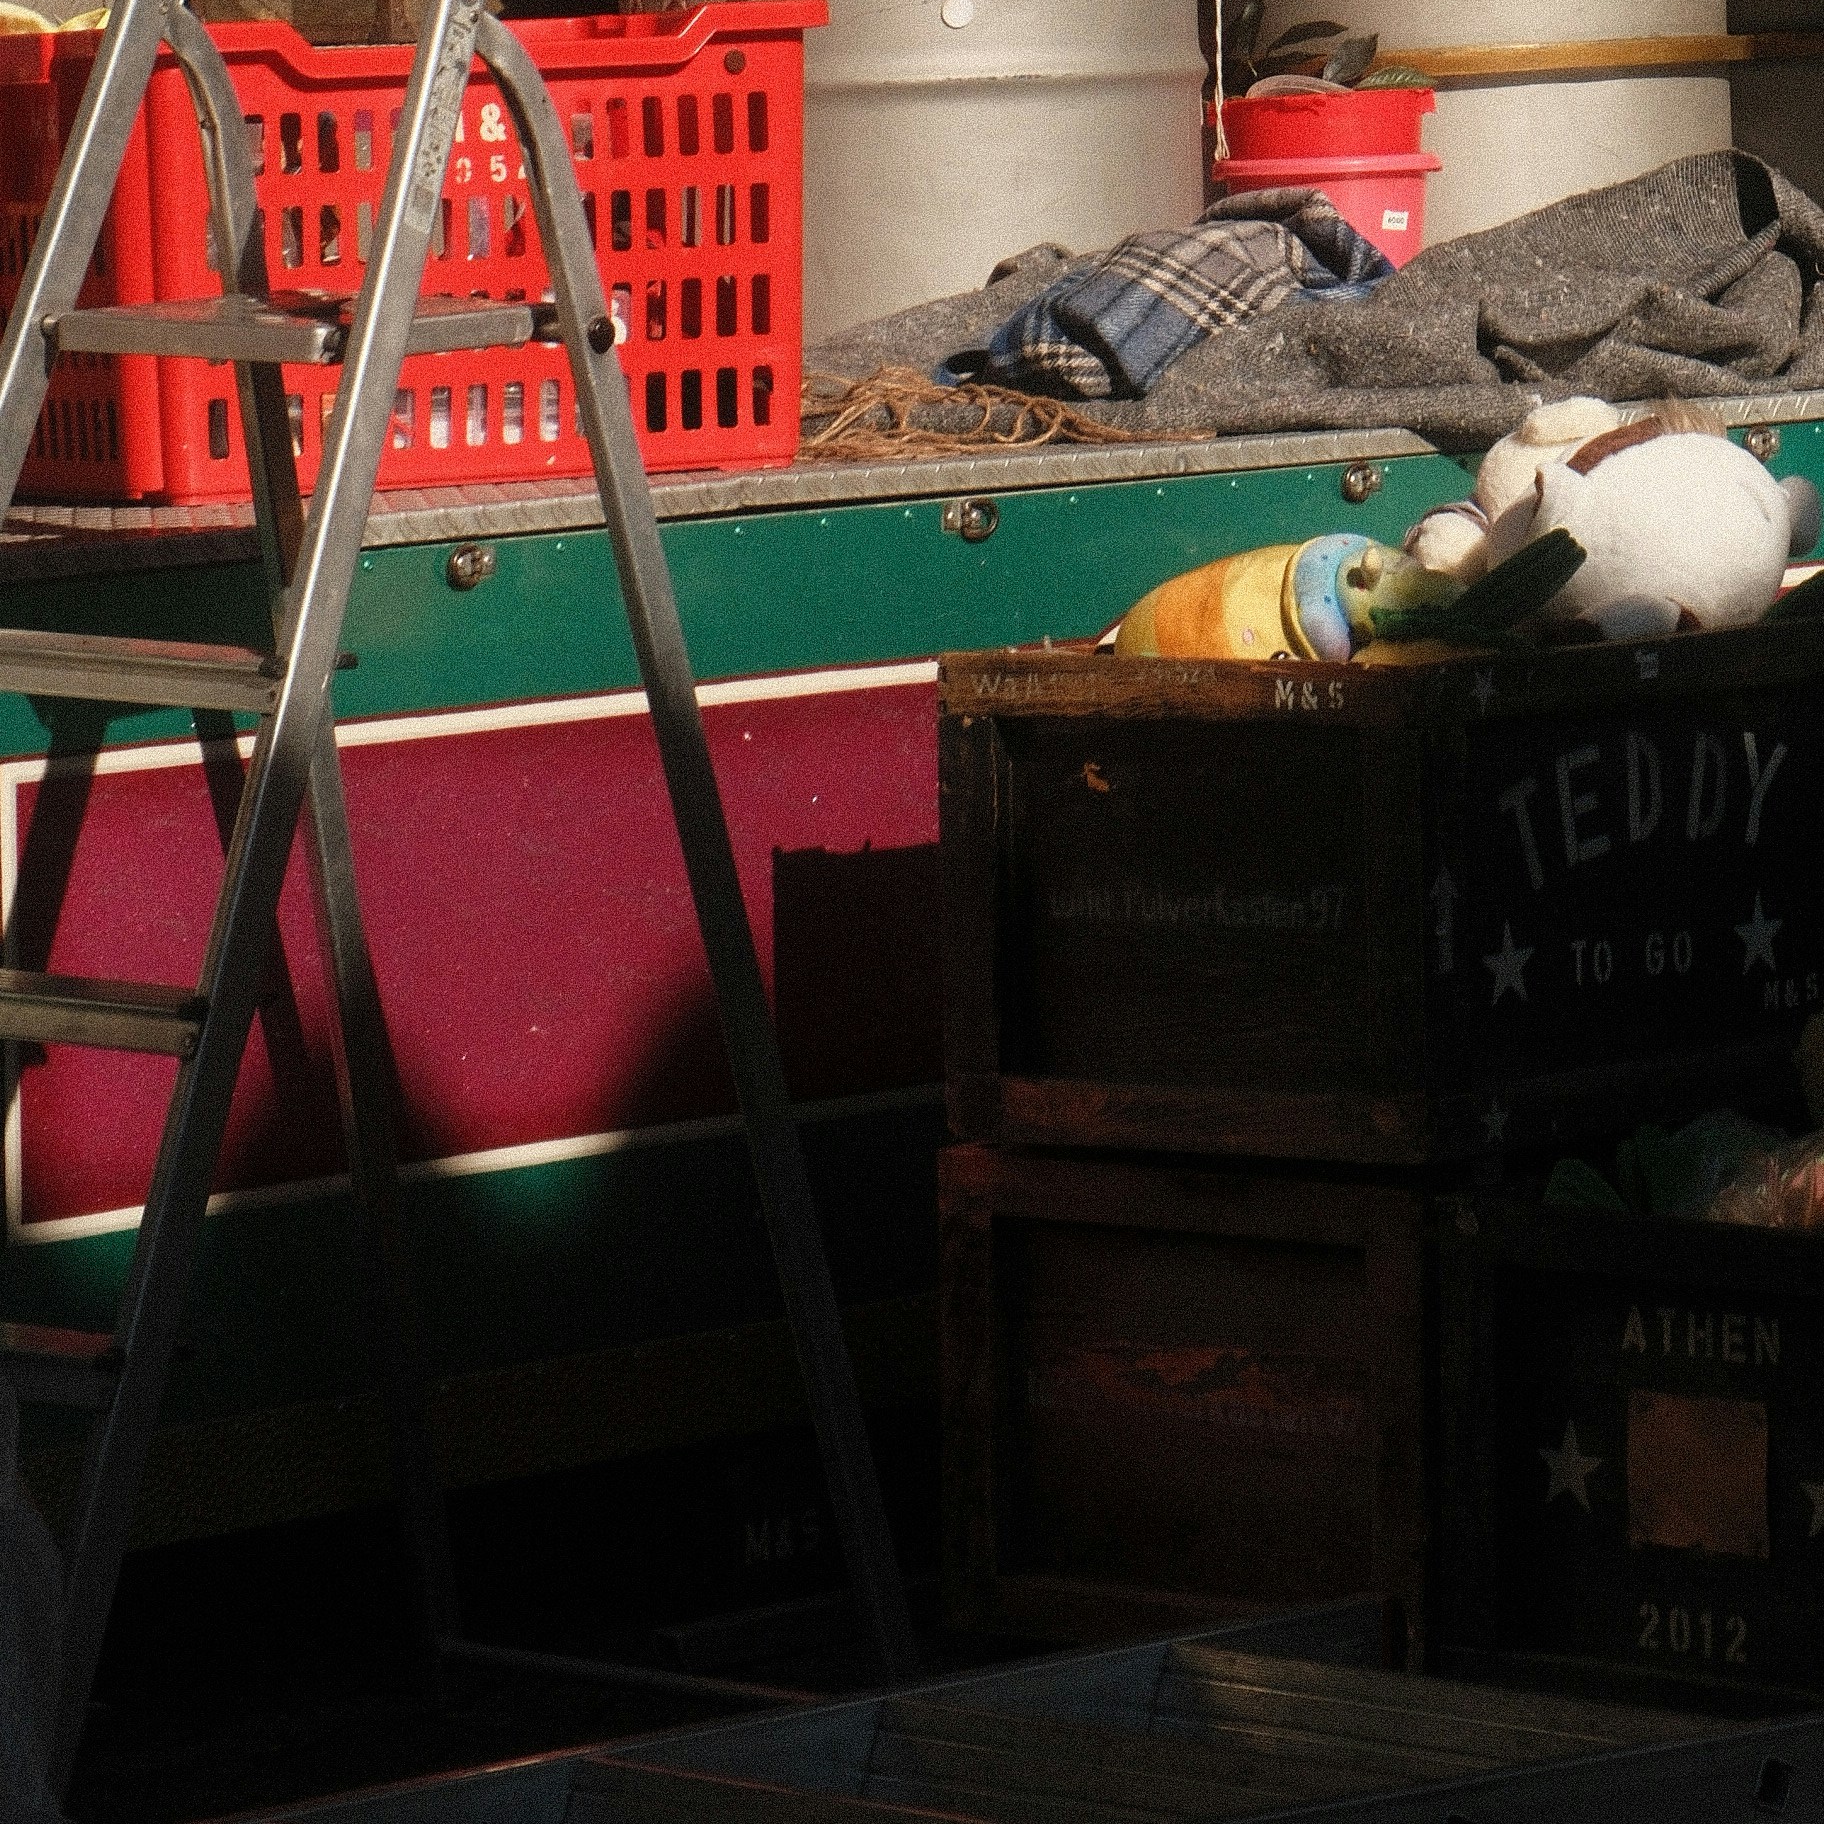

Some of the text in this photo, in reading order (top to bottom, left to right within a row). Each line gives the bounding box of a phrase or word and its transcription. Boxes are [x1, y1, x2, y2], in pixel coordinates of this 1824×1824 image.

[1499, 729, 1789, 893] TEDDY
[1570, 930, 1694, 988] TO GO
[1621, 1303, 1781, 1366] ATHEN
[1638, 1602, 1748, 1664] 2012
